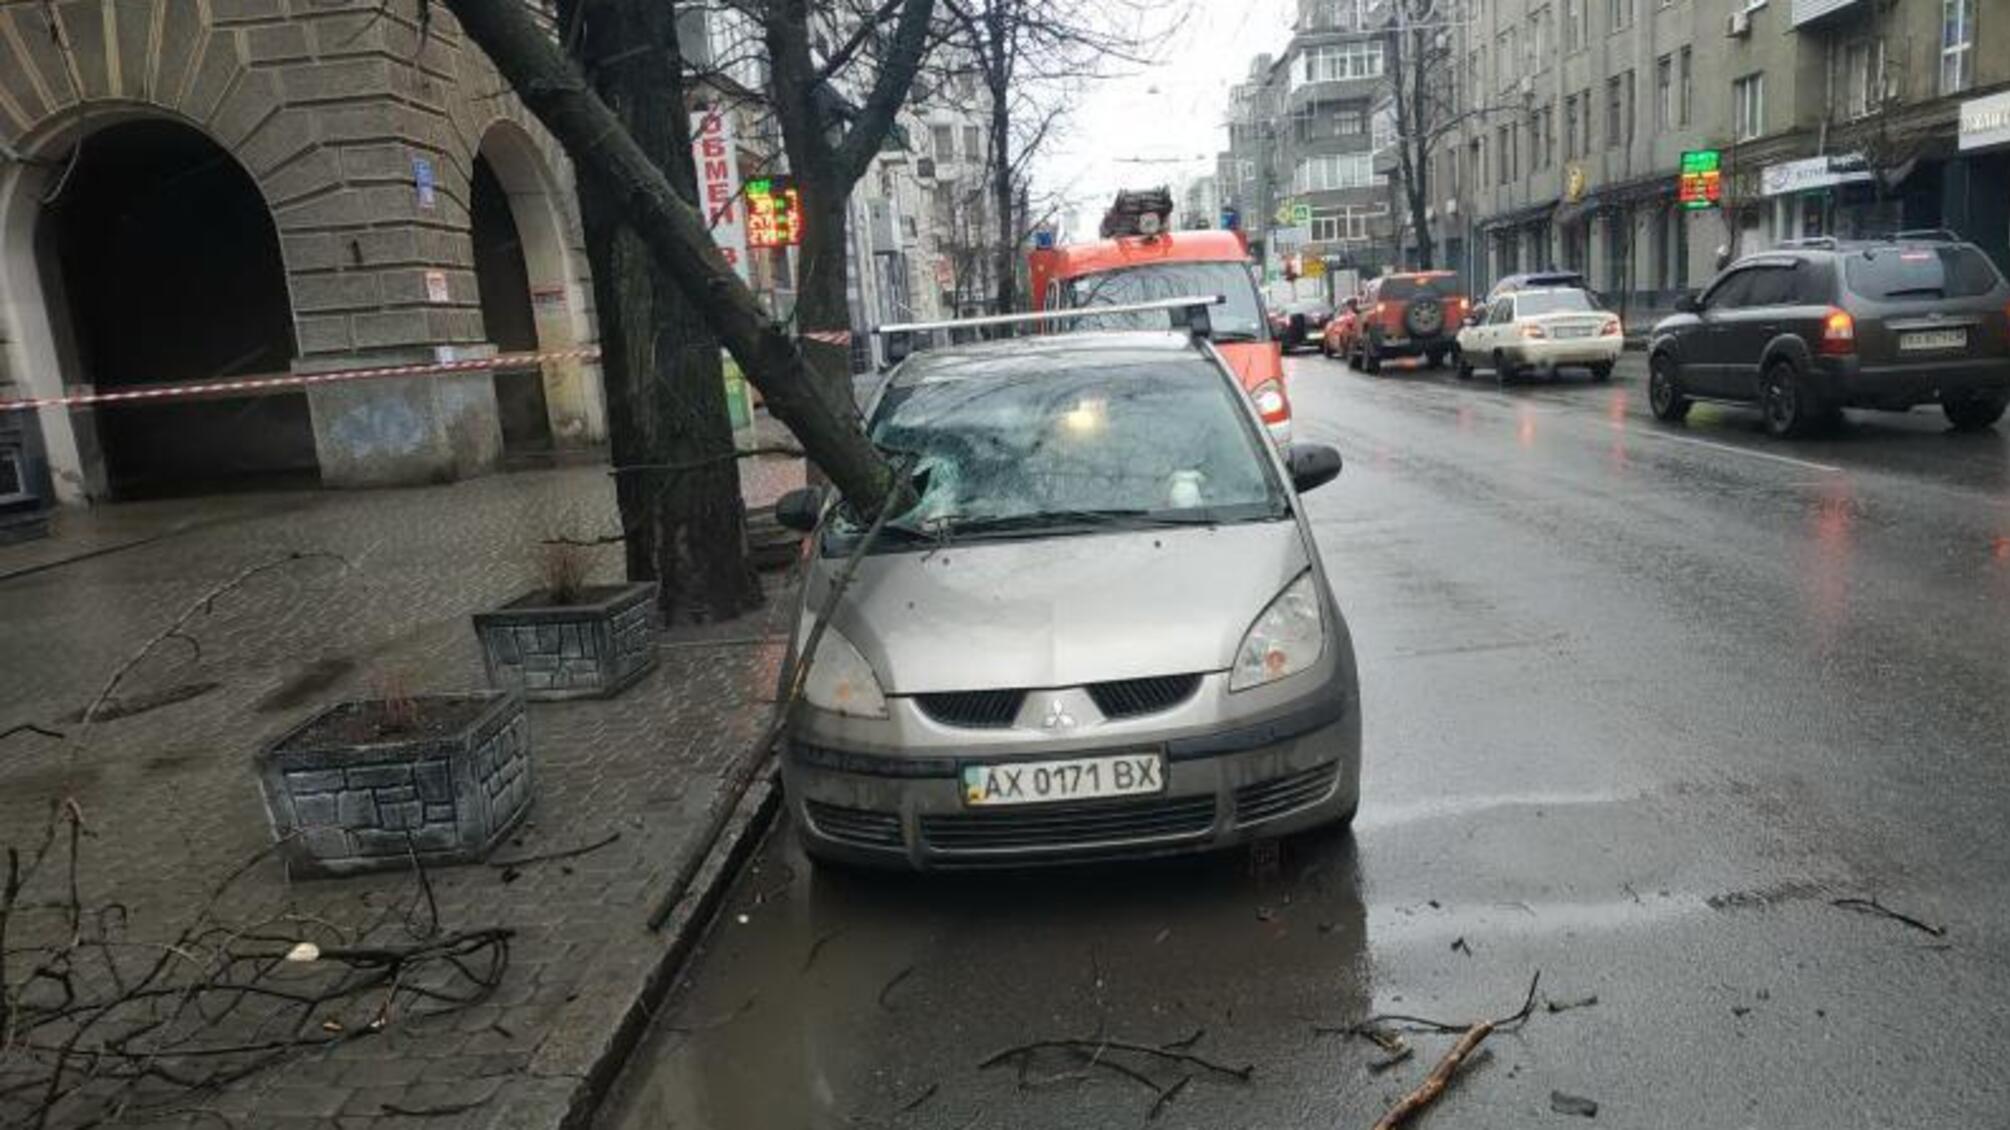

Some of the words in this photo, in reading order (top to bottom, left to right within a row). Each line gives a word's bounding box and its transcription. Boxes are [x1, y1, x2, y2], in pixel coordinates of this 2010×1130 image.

[985, 768, 1024, 799] AX
[1033, 763, 1101, 796] 0171
[1113, 758, 1157, 790] BX
